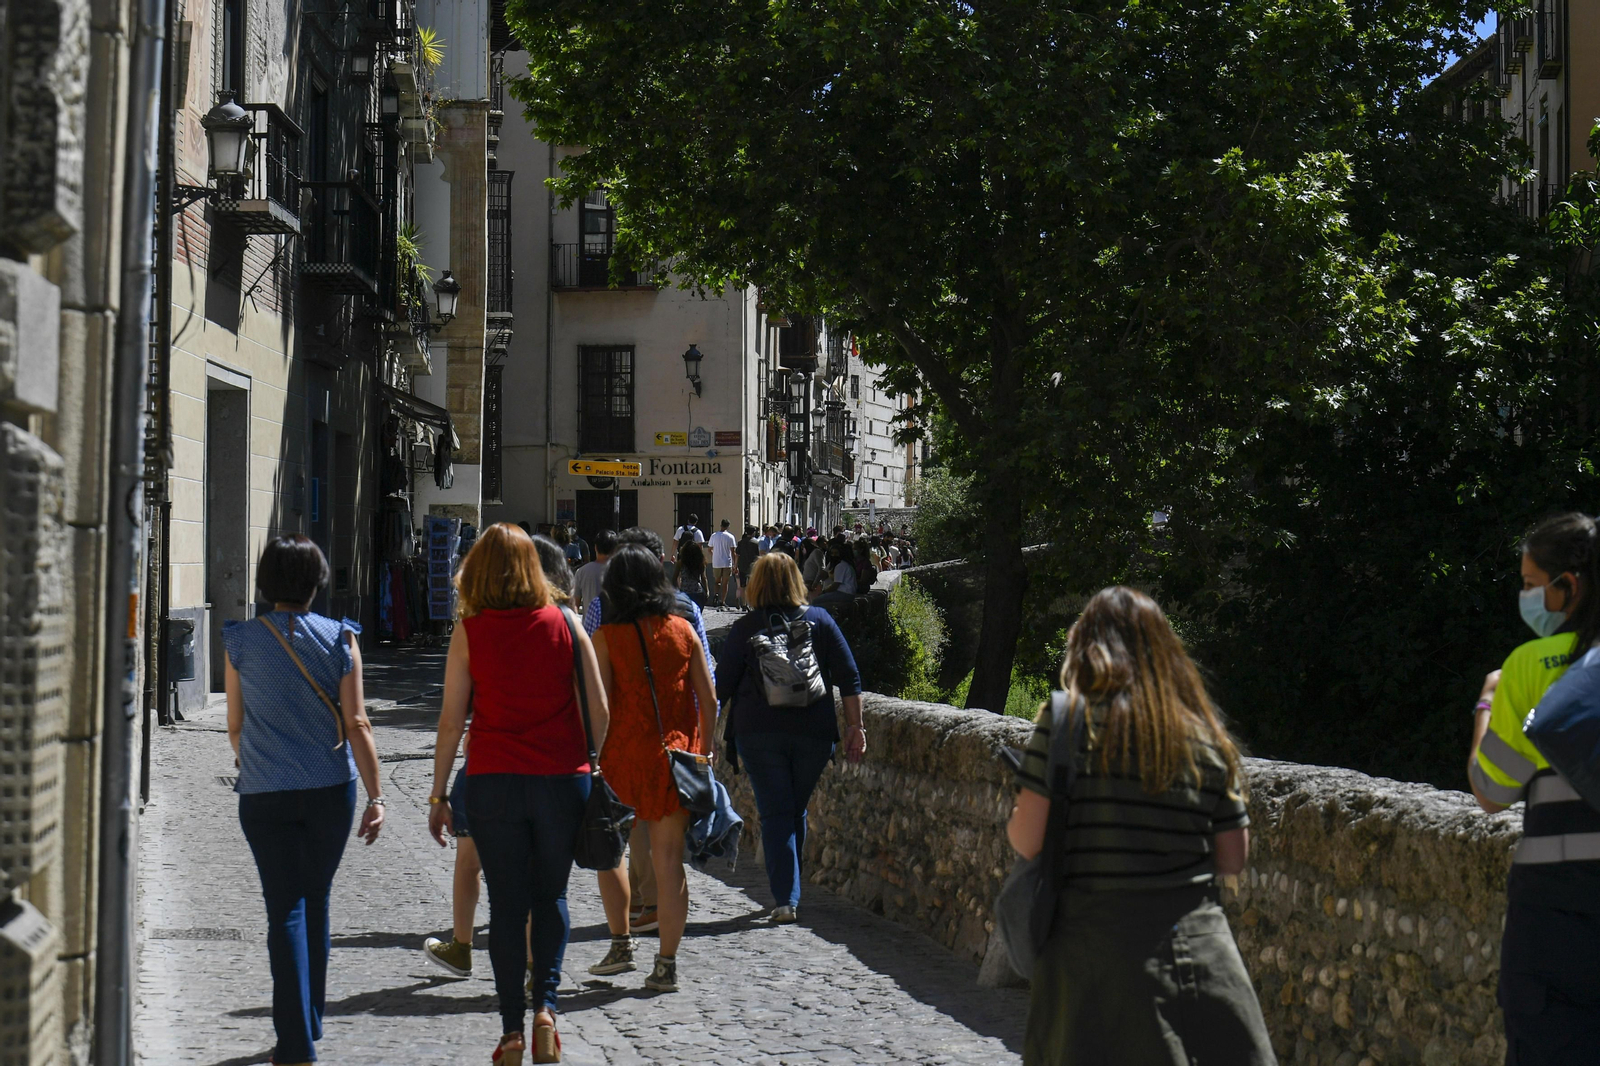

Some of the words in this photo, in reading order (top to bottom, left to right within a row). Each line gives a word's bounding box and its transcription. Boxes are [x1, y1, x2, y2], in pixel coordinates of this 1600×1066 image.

[649, 458, 722, 476] Fontana
[630, 478, 671, 487] Andalusian
[676, 478, 692, 486] bar
